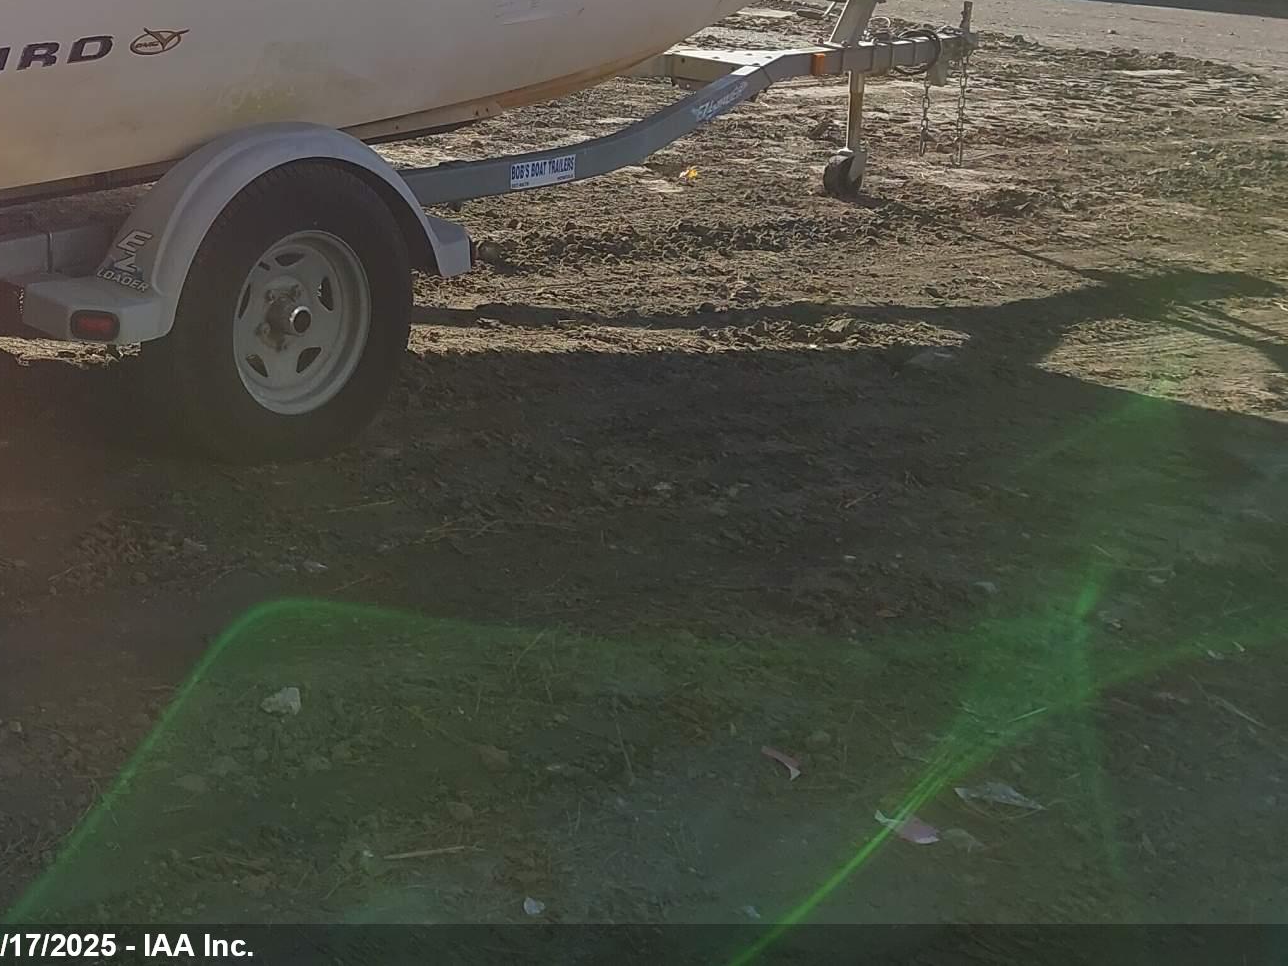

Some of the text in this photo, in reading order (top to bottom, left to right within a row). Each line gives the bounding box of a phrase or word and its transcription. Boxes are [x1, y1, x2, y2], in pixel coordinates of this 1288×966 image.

[511, 156, 575, 181] BOB'S BOAT TRAILERS
[96, 268, 150, 293] LOADER
